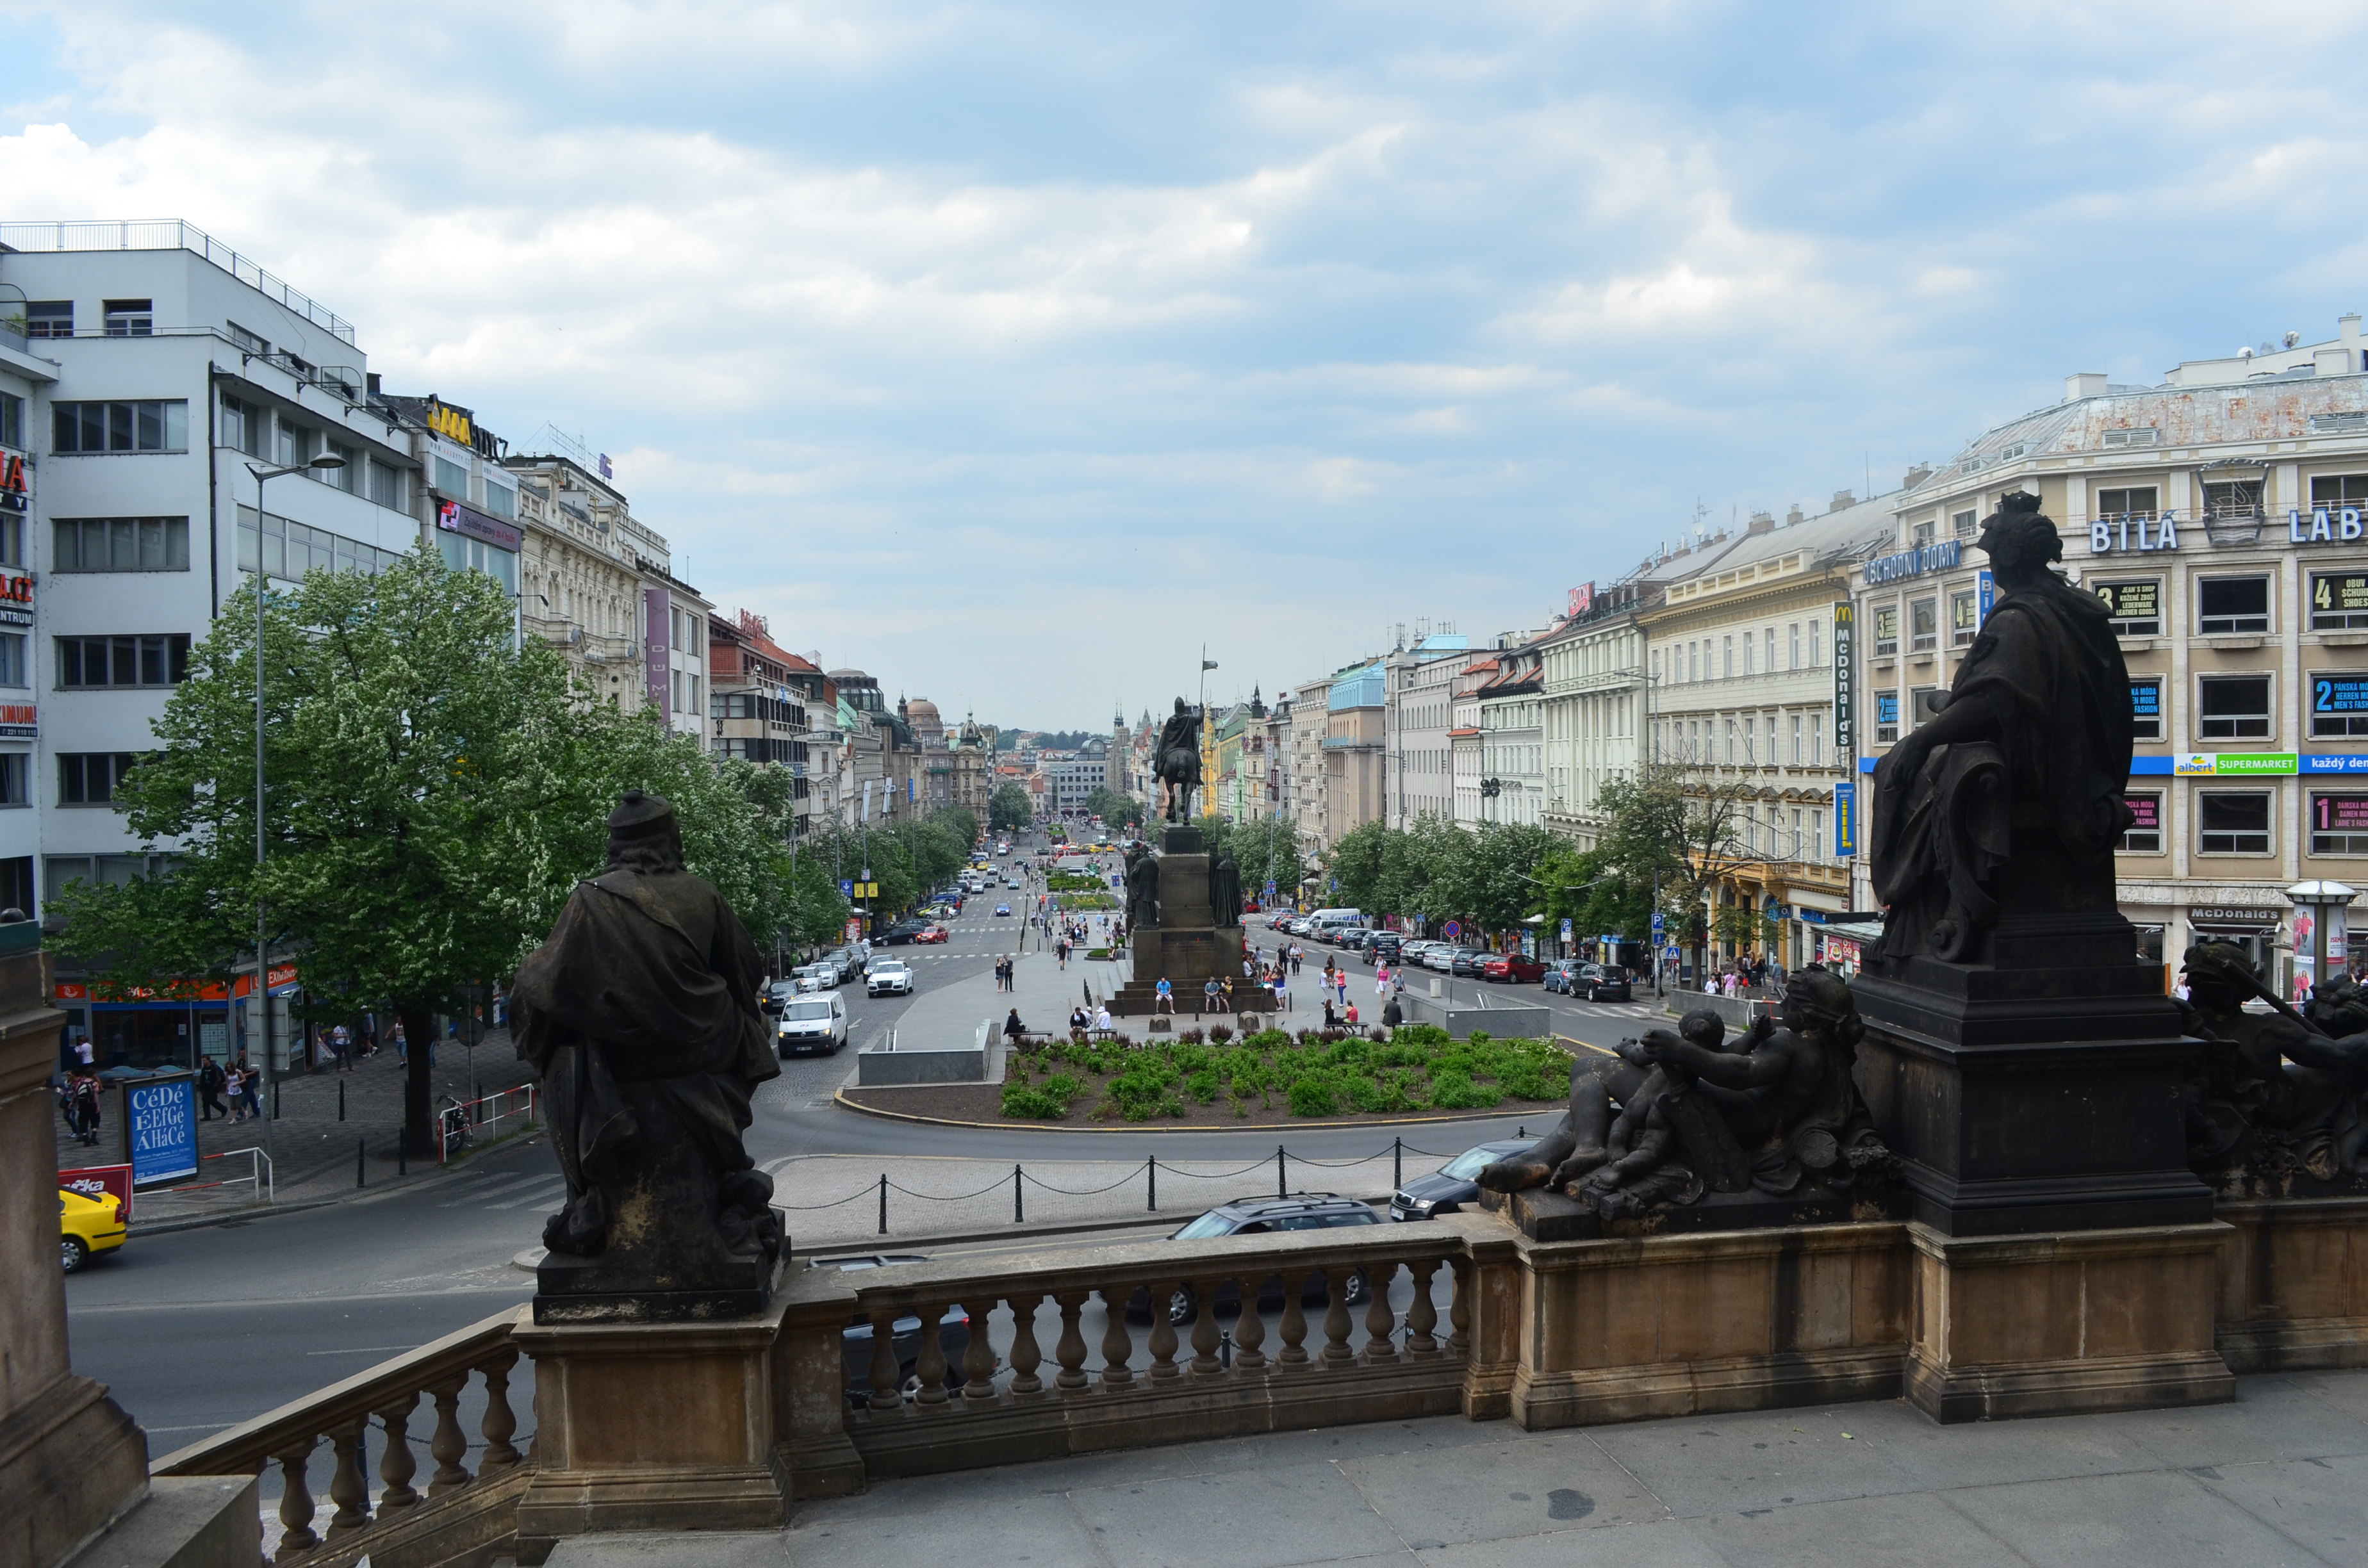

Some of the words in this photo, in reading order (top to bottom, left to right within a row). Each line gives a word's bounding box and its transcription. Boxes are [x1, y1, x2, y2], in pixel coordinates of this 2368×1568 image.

[2091, 509, 2178, 553] BÍLÁ
[2289, 507, 2363, 544] LAB
[1923, 541, 1959, 571] DOMY
[2315, 578, 2332, 608] 4
[2346, 578, 2366, 588] OBUV
[1957, 600, 1964, 627] 4
[2344, 598, 2368, 608] SHOES
[1878, 614, 1884, 639] 3
[2316, 681, 2332, 710] 2
[2334, 682, 2358, 691] PÁNSKÁ
[1879, 697, 1885, 723] 2
[2134, 705, 2158, 713] FASHION
[2140, 696, 2157, 704] MODE
[0, 705, 37, 724] IMUM!
[2178, 763, 2213, 772] albert
[2219, 760, 2294, 769] SUPERMARKET
[2312, 757, 2346, 770] každý
[2317, 798, 2328, 829] 1
[2191, 908, 2278, 919] McDonald's
[133, 1084, 184, 1110] CéDé
